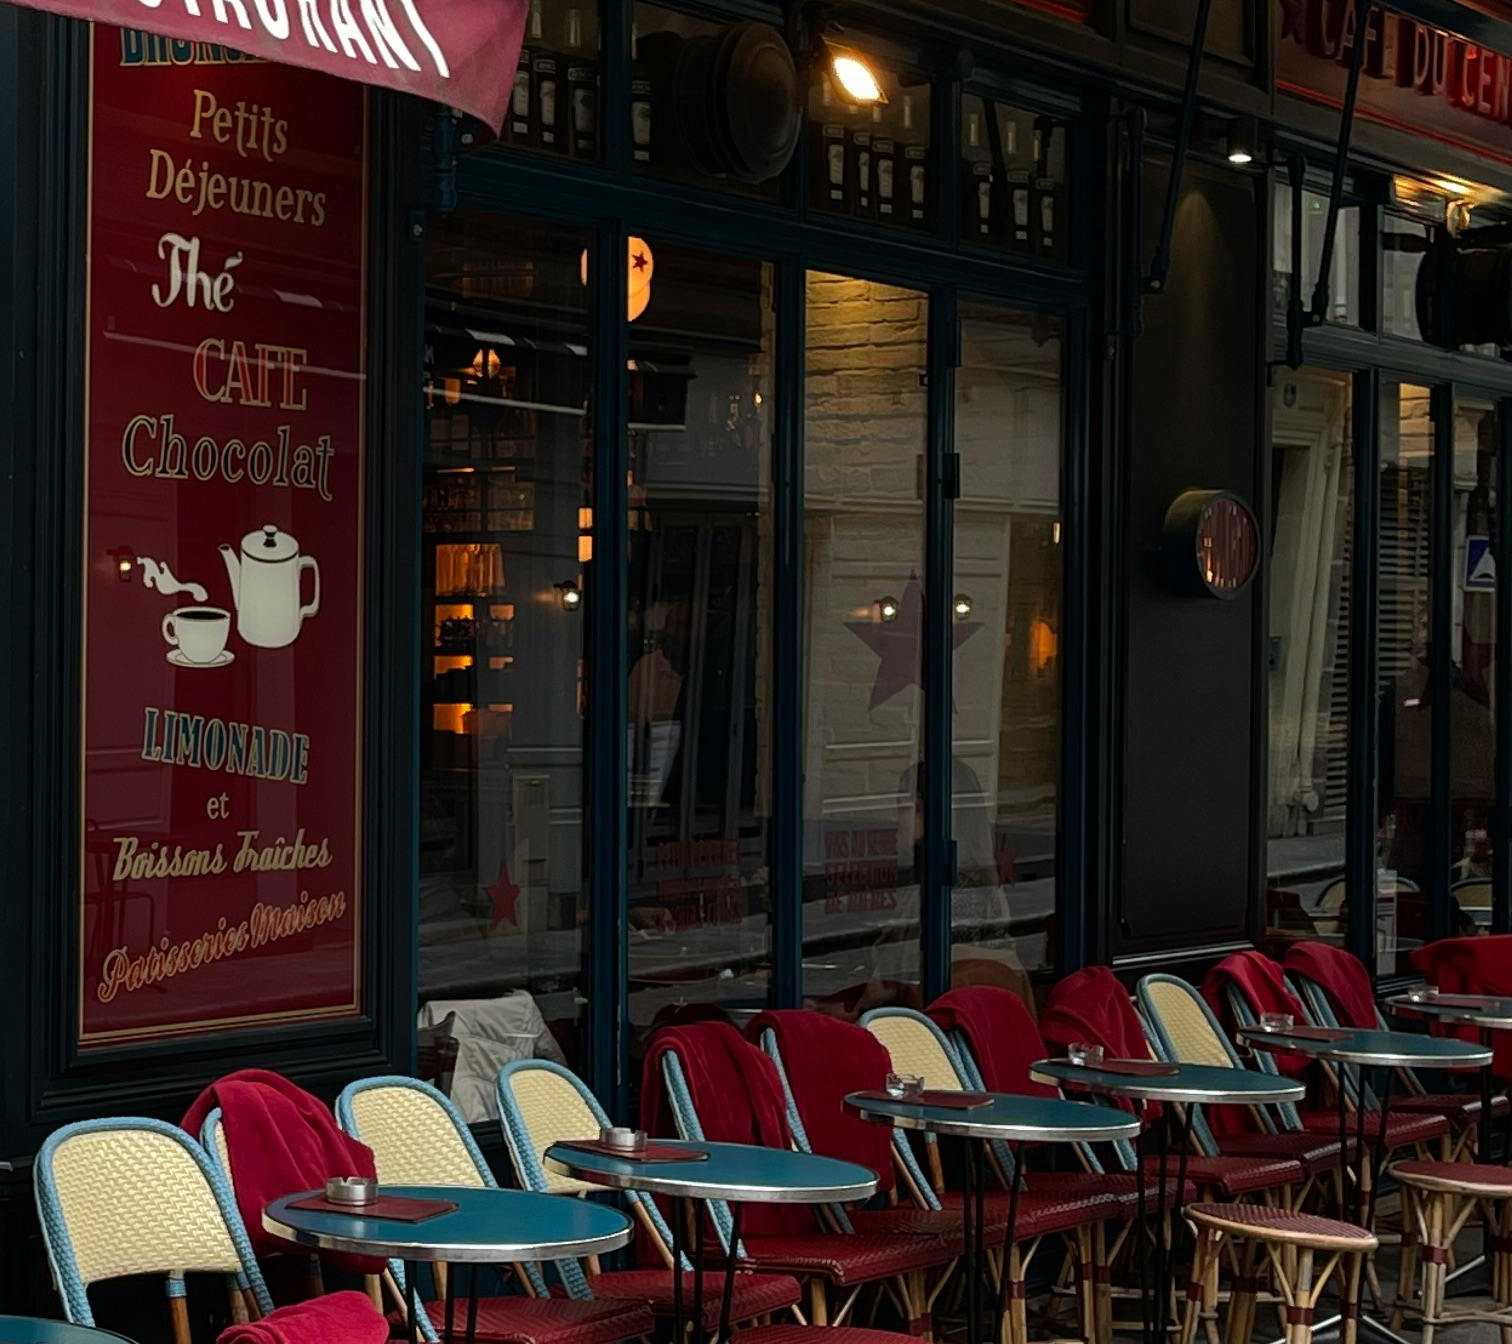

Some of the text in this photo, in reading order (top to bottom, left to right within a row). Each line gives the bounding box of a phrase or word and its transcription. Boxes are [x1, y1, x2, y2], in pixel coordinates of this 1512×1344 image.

[190, 89, 288, 161] Petits
[146, 148, 326, 227] Déjeuners
[152, 232, 243, 312] Thé
[193, 338, 308, 411] CAFE
[123, 414, 335, 501] Chocolat
[141, 707, 310, 785] LIMONADE
[206, 792, 230, 820] et
[112, 829, 333, 881] Boissons Fraîches
[250, 889, 346, 949] Maison
